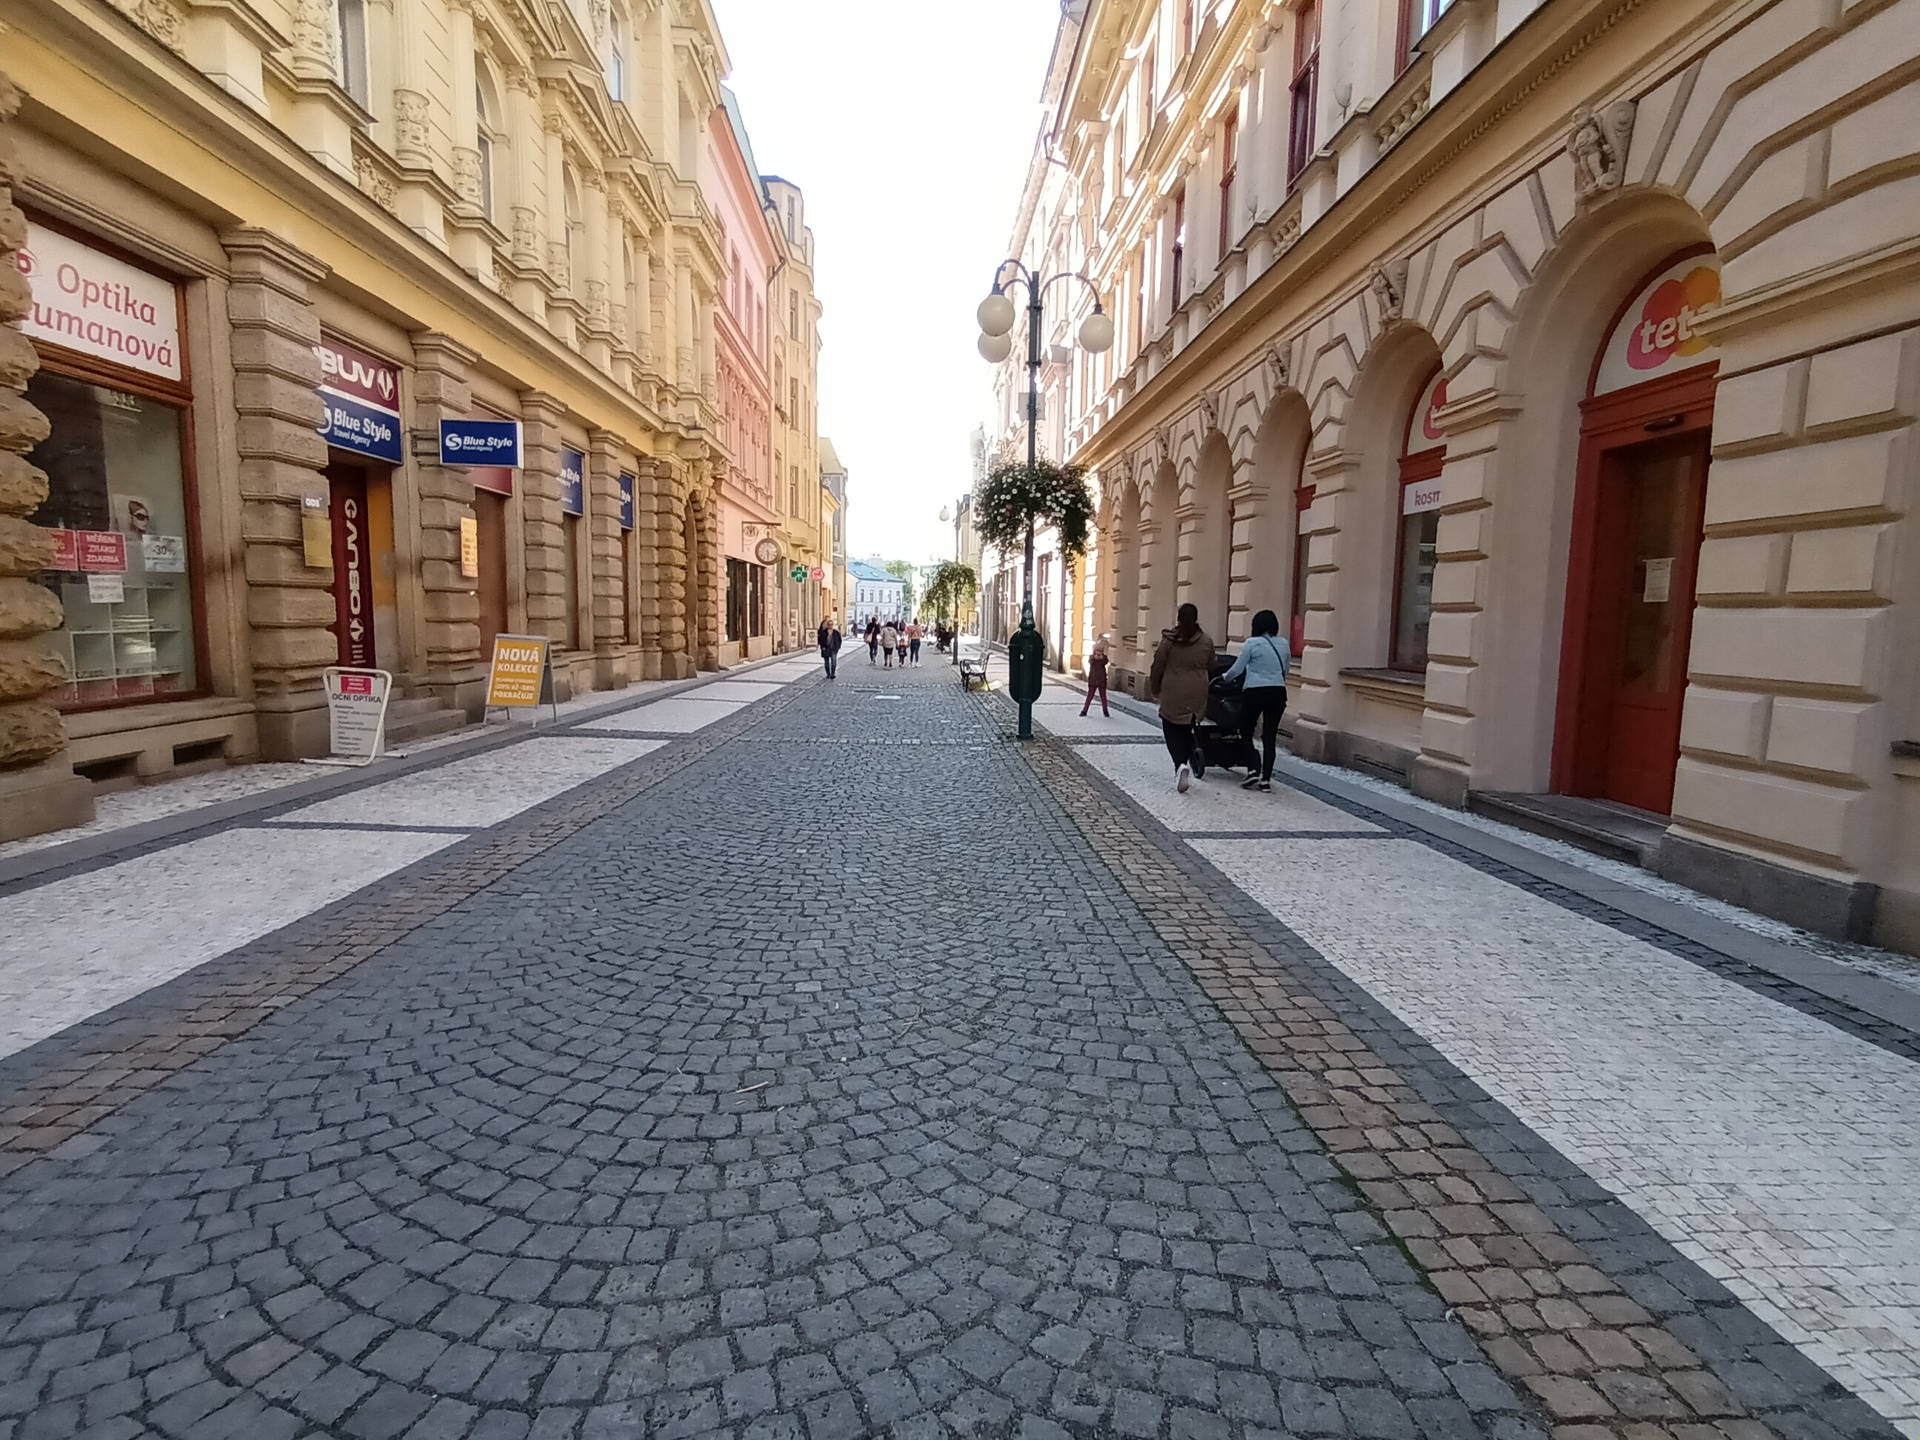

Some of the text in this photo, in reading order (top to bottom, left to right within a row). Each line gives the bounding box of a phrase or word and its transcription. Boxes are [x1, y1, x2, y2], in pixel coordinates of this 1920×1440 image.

[57, 263, 156, 326] Optika
[31, 301, 172, 368] umanová
[312, 346, 375, 389] BUV
[333, 407, 392, 442] Blue Style
[333, 427, 371, 448] Travel Agency
[463, 435, 513, 449] Blue Style
[86, 554, 120, 563] ZDARMA
[346, 519, 361, 615] OBUV
[499, 646, 539, 662] NOVÁ
[497, 662, 538, 674] KOLEKCE
[352, 694, 382, 703] OPTIKA
